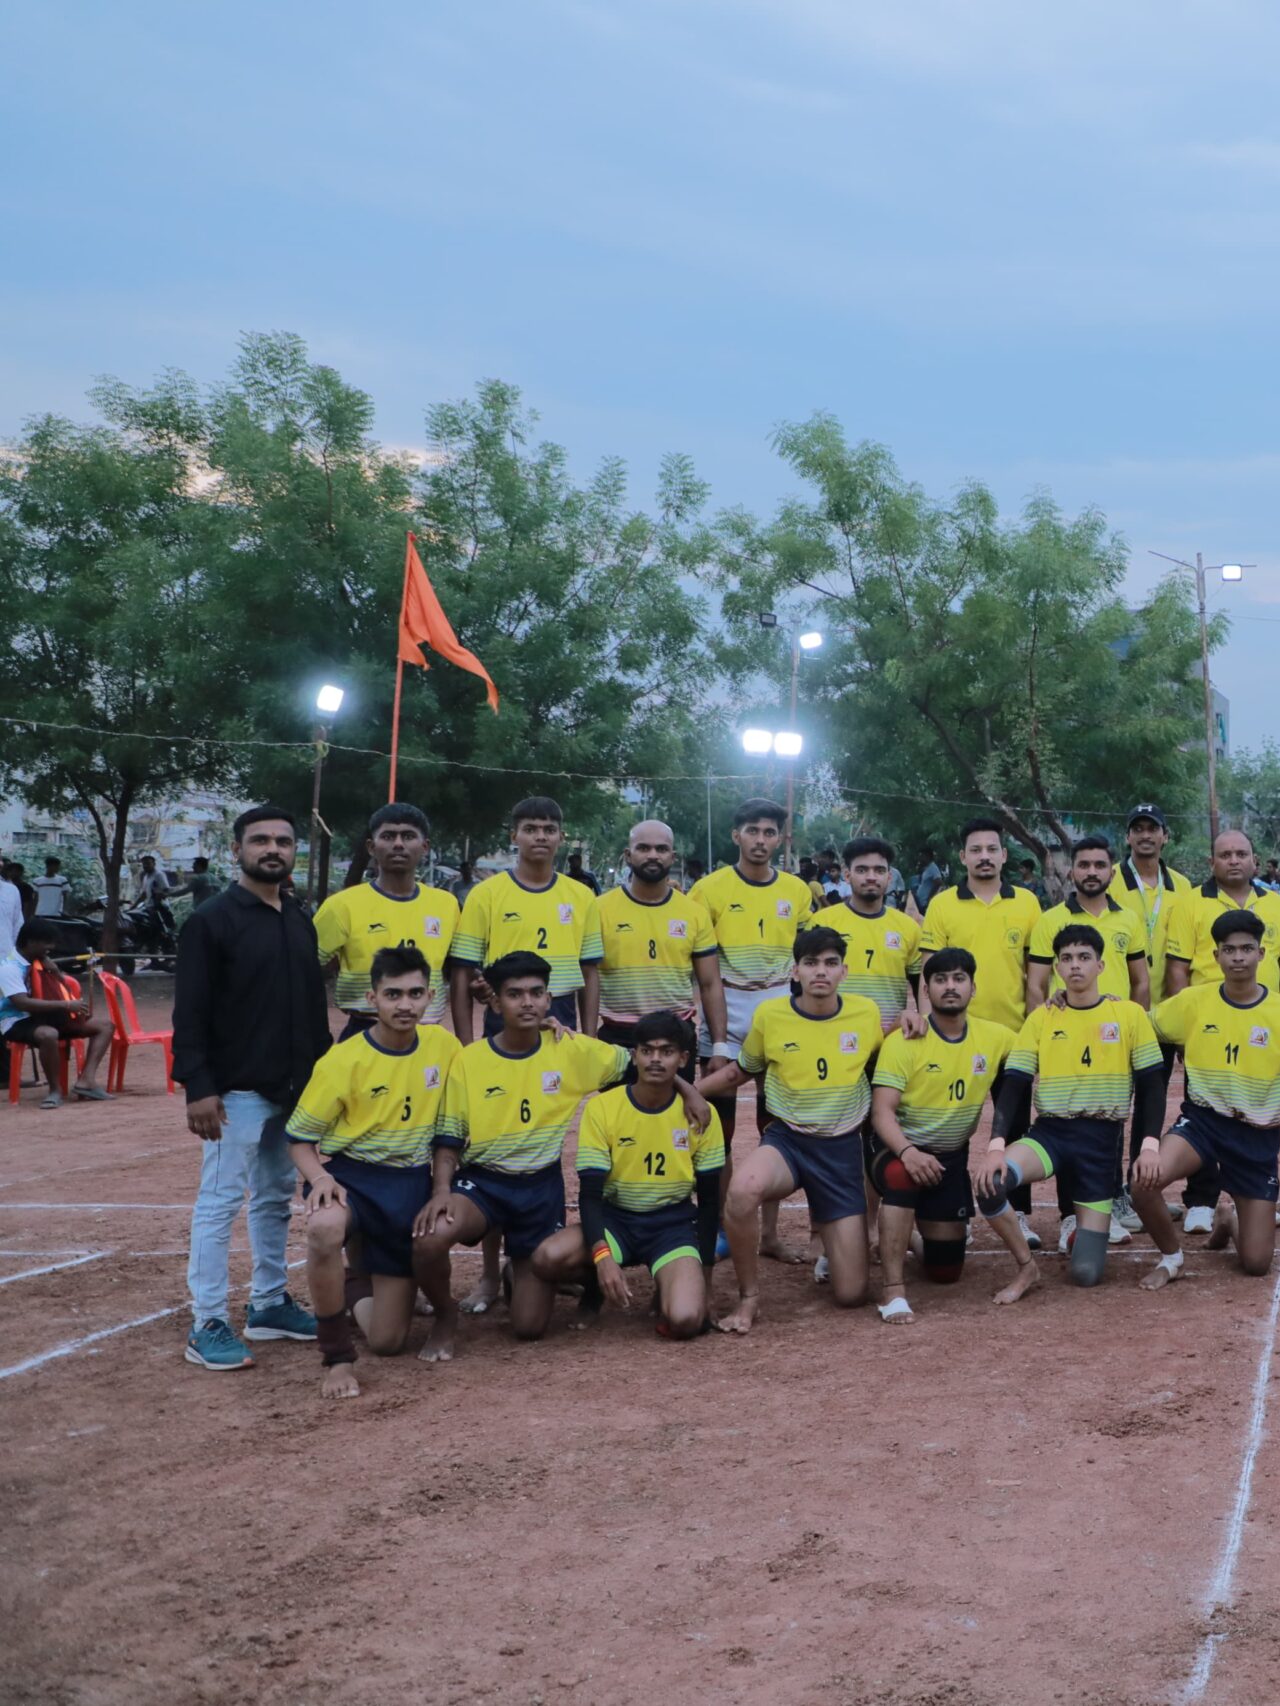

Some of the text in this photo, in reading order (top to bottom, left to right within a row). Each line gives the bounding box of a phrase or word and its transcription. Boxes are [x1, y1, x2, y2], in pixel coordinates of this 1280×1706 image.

[537, 927, 548, 950] 2
[758, 918, 764, 939] 1
[648, 939, 657, 960] 8
[864, 949, 874, 969] 7
[1081, 1044, 1092, 1066] 4
[1225, 1042, 1240, 1067] 11
[816, 1057, 828, 1081] 9
[948, 1079, 965, 1102] 10
[520, 1098, 532, 1124] 6
[644, 1152, 666, 1176] 12
